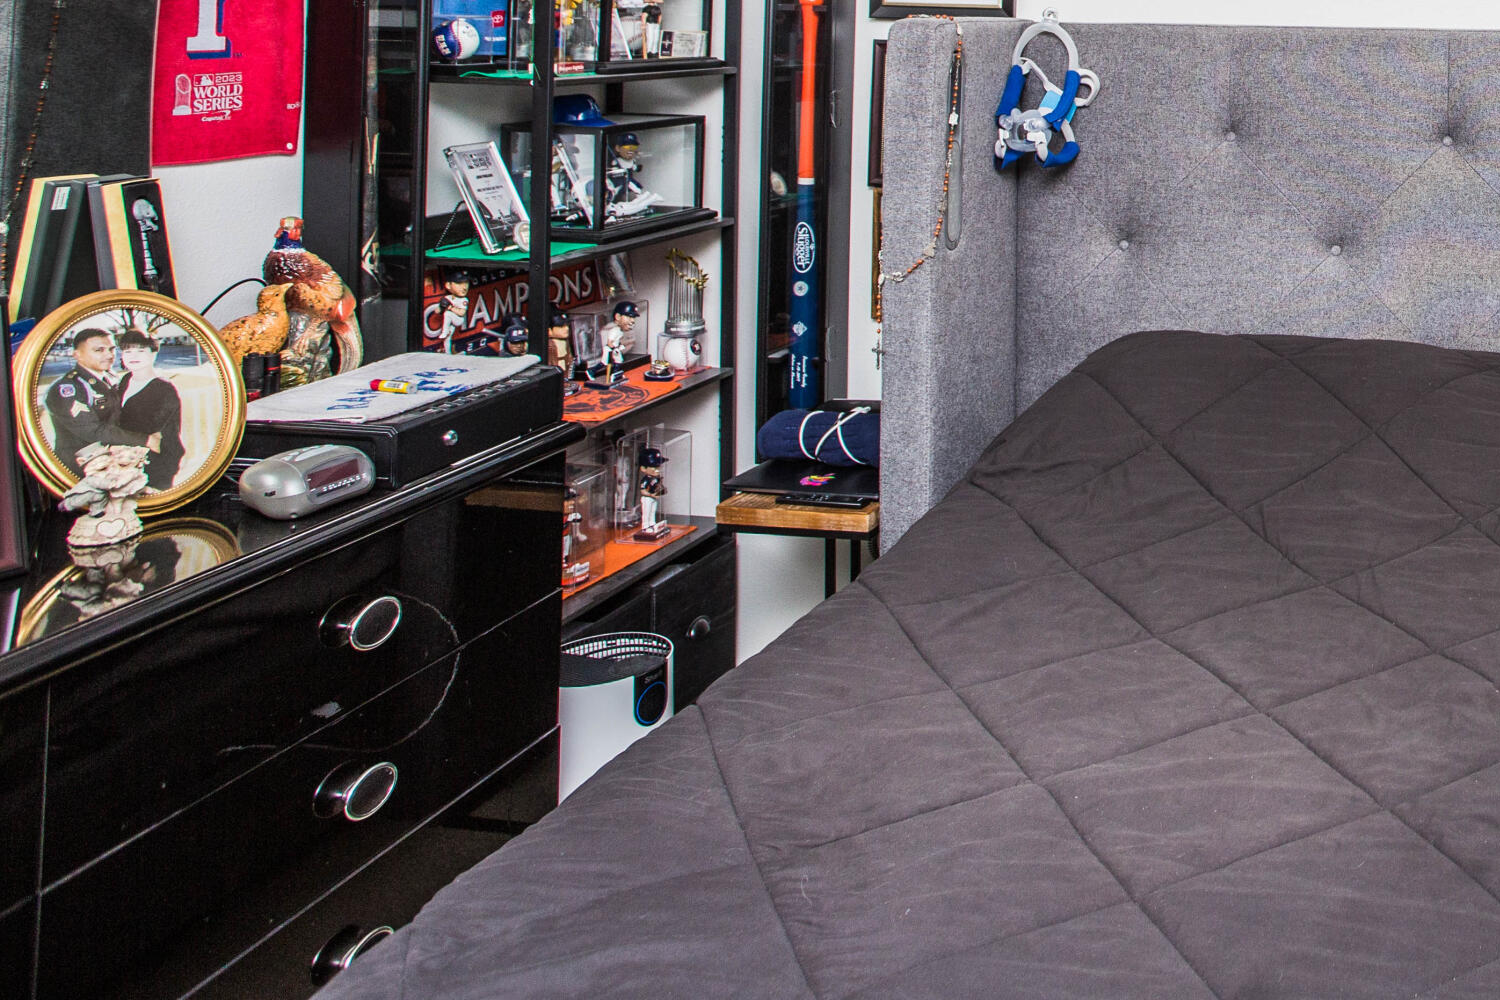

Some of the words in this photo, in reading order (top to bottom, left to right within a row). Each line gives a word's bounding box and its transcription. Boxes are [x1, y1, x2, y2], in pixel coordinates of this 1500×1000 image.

[215, 74, 243, 83] 2023
[193, 84, 243, 98] WORLD
[193, 96, 243, 112] SERIES
[795, 226, 810, 269] Slugger
[423, 266, 593, 339] CAMPONS
